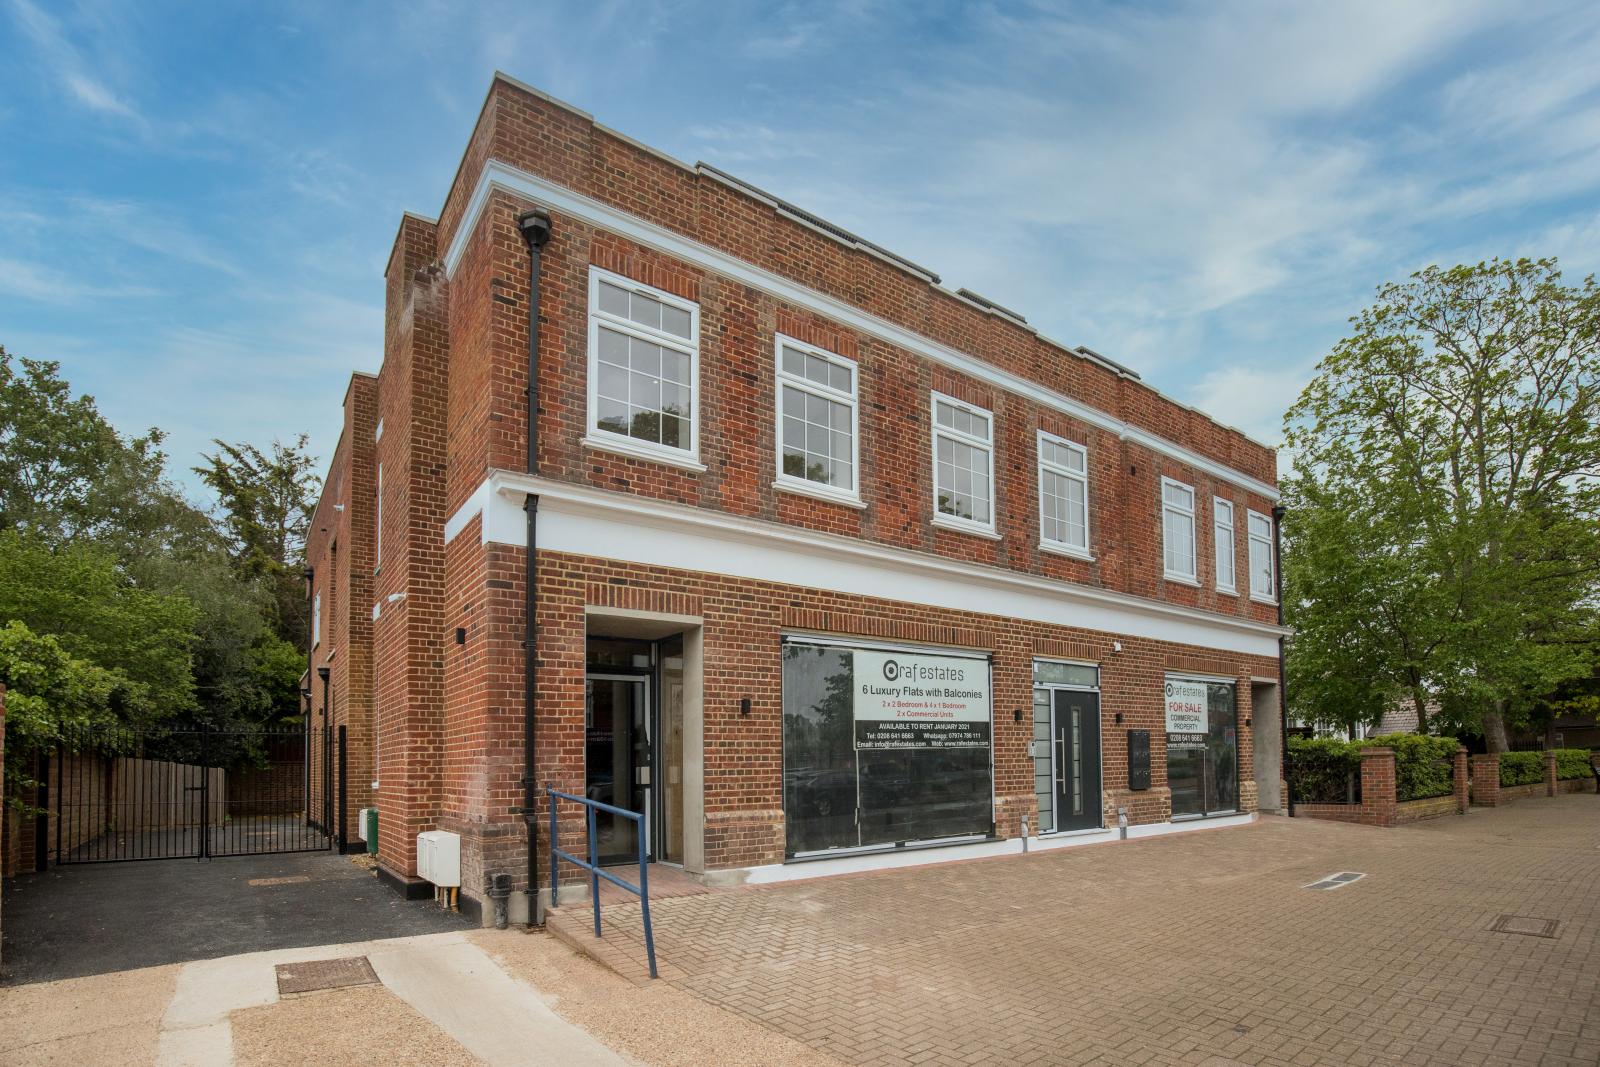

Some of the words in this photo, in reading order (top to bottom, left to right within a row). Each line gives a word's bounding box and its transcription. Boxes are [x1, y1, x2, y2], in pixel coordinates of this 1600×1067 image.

[920, 666, 964, 681] estates
[862, 685, 868, 694] 6
[870, 685, 900, 698] Luxury
[903, 687, 923, 697] Flats
[925, 688, 942, 698] with
[944, 688, 983, 699] Balconies
[1183, 687, 1206, 698] estates
[1169, 702, 1183, 712] FOR
[1184, 703, 1202, 713] SALE
[906, 710, 939, 718] Commercial
[1170, 714, 1201, 722] COMMERCIAL
[1173, 723, 1198, 731] PROPERTY
